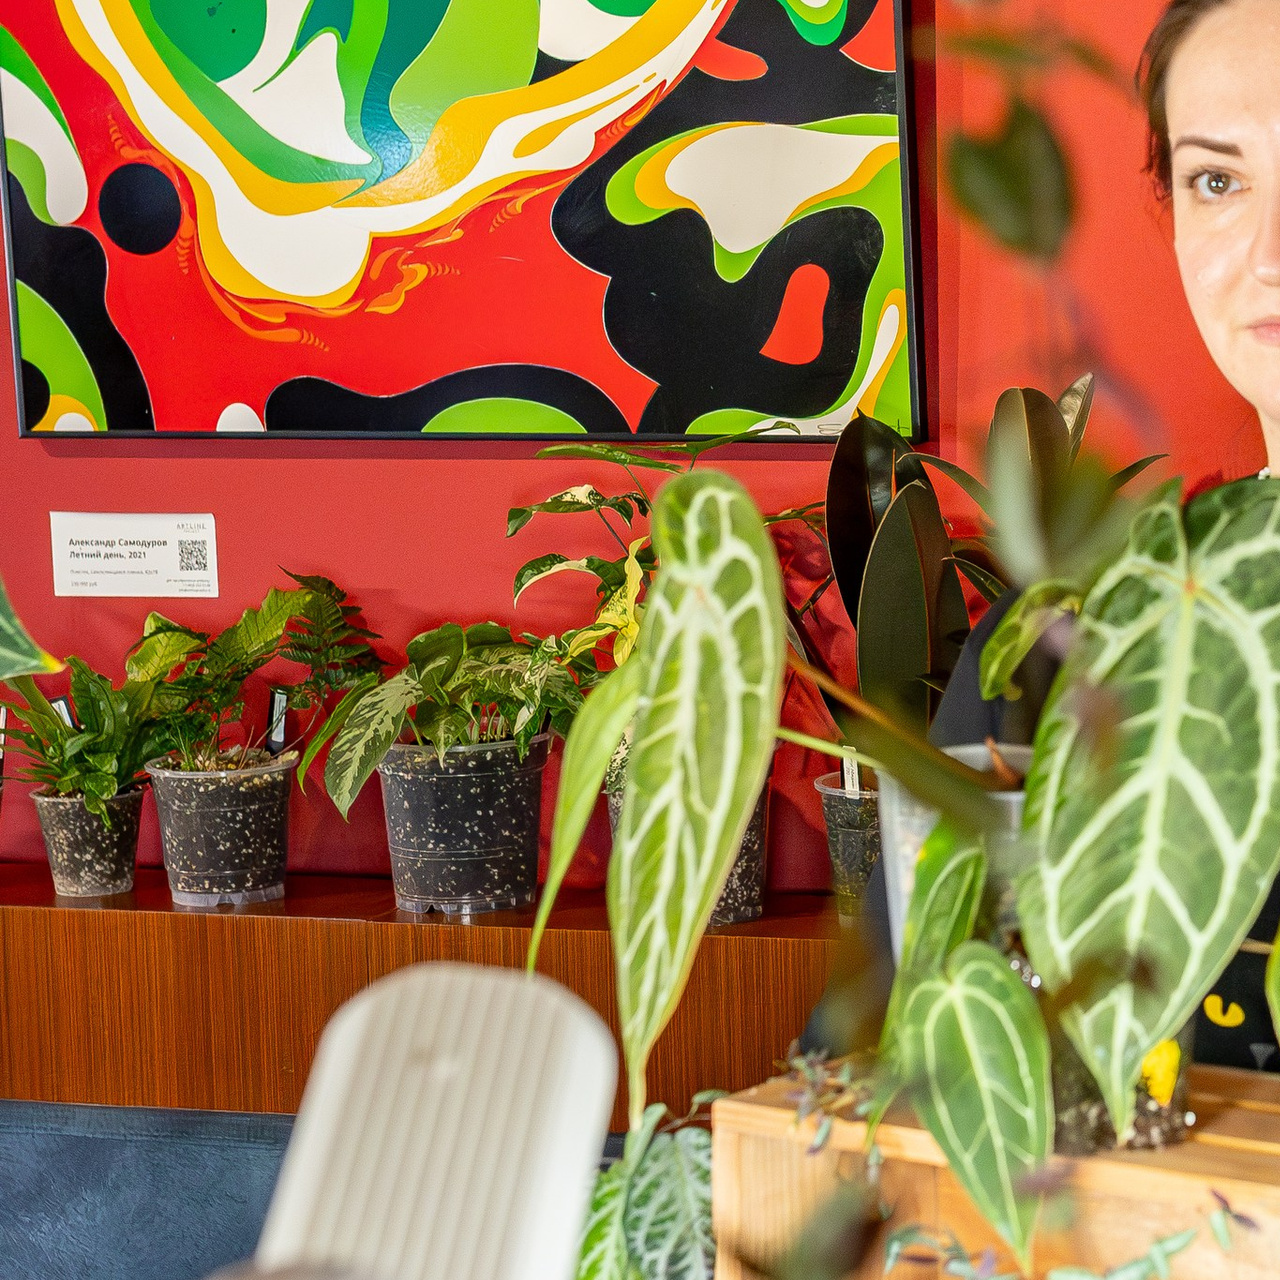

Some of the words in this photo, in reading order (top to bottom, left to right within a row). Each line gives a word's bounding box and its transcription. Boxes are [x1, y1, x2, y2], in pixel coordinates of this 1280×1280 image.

[68, 537, 117, 549] Александр
[118, 538, 168, 549] Самодуров
[69, 550, 102, 559] Летний
[128, 550, 147, 559] 2021
